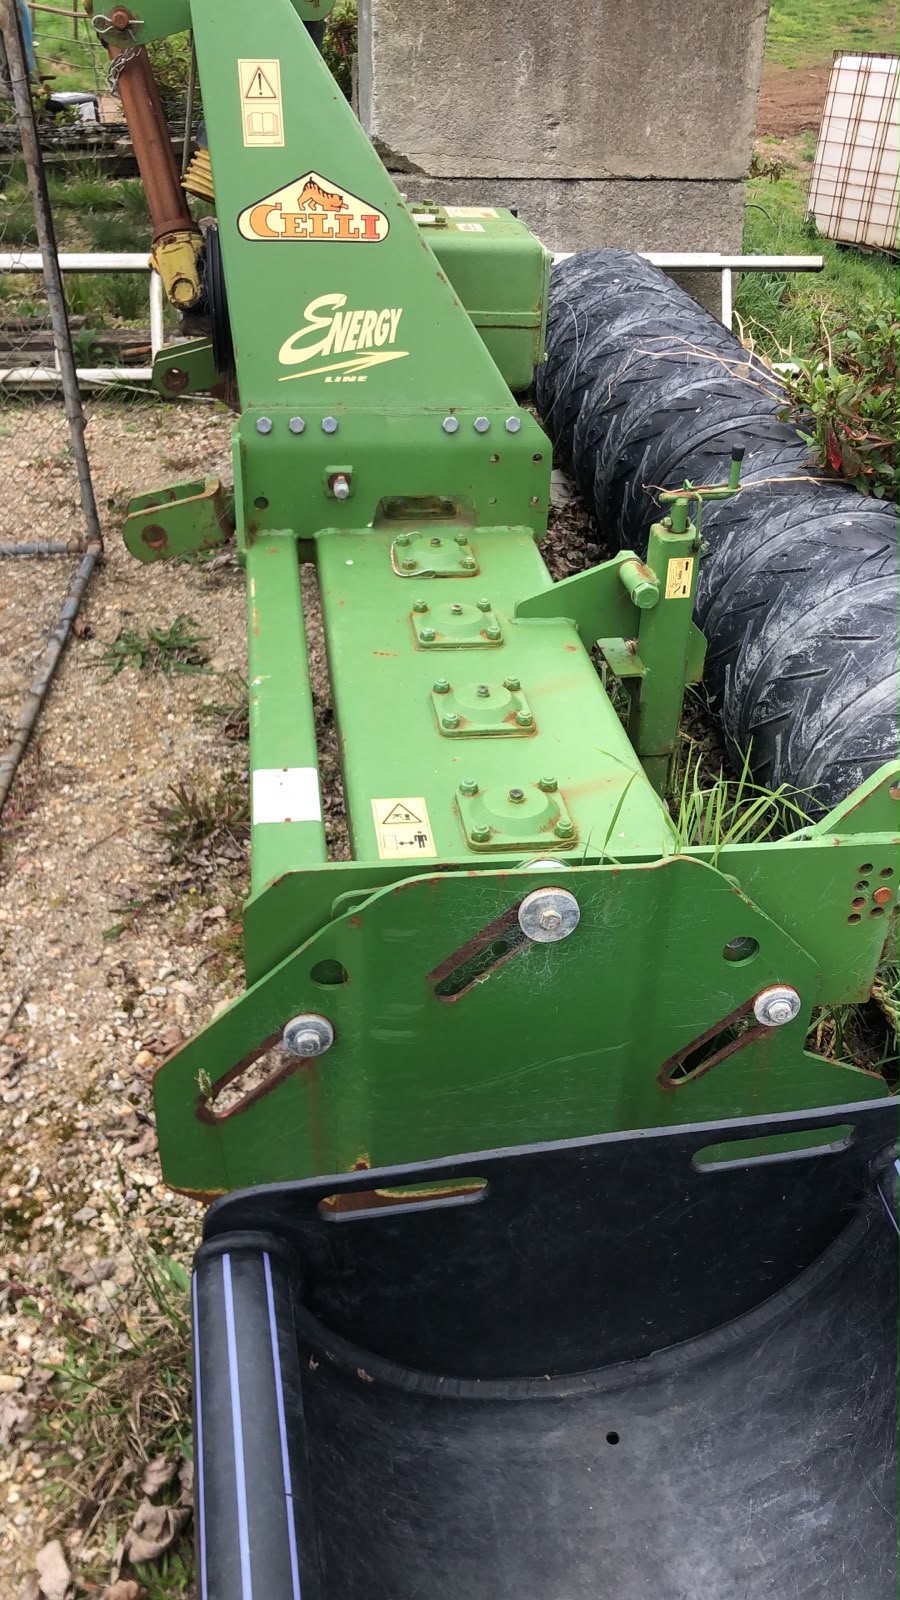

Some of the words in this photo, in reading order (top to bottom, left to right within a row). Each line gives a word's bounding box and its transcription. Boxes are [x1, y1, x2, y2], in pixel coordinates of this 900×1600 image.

[249, 202, 381, 240] CELLI
[278, 293, 403, 365] ENERGY
[324, 375, 368, 383] LINE
